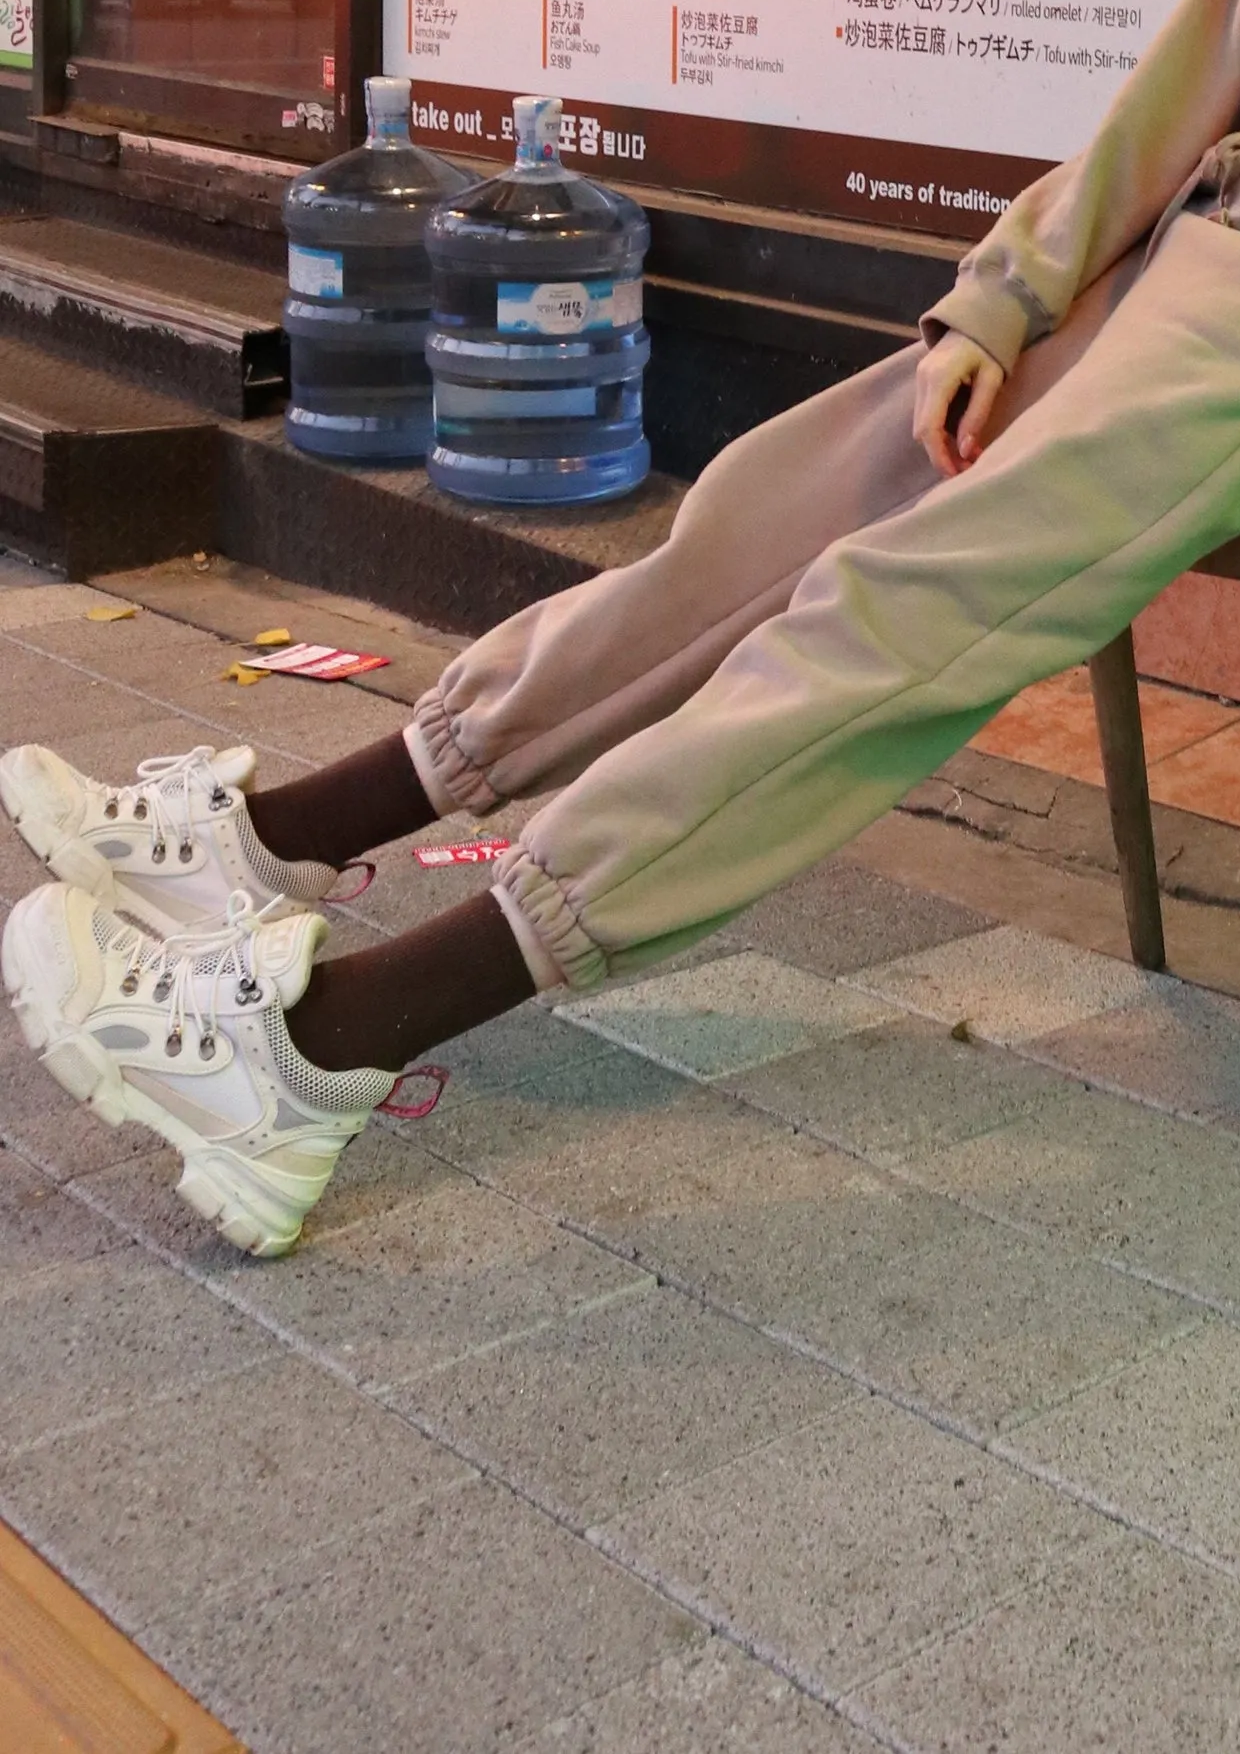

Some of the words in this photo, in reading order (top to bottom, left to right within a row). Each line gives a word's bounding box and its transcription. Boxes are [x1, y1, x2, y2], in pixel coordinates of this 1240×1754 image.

[1011, 0, 1042, 19] rolled
[1044, 3, 1082, 22] omelet
[1092, 6, 1142, 29] 계란말이
[844, 18, 947, 56] 炒泡菜佐豆腐
[1043, 45, 1066, 65] Tofu
[1068, 47, 1092, 66] with
[412, 101, 449, 131] take
[454, 112, 483, 136] out
[846, 171, 866, 193] 40
[870, 179, 914, 201] years
[918, 183, 935, 203] of
